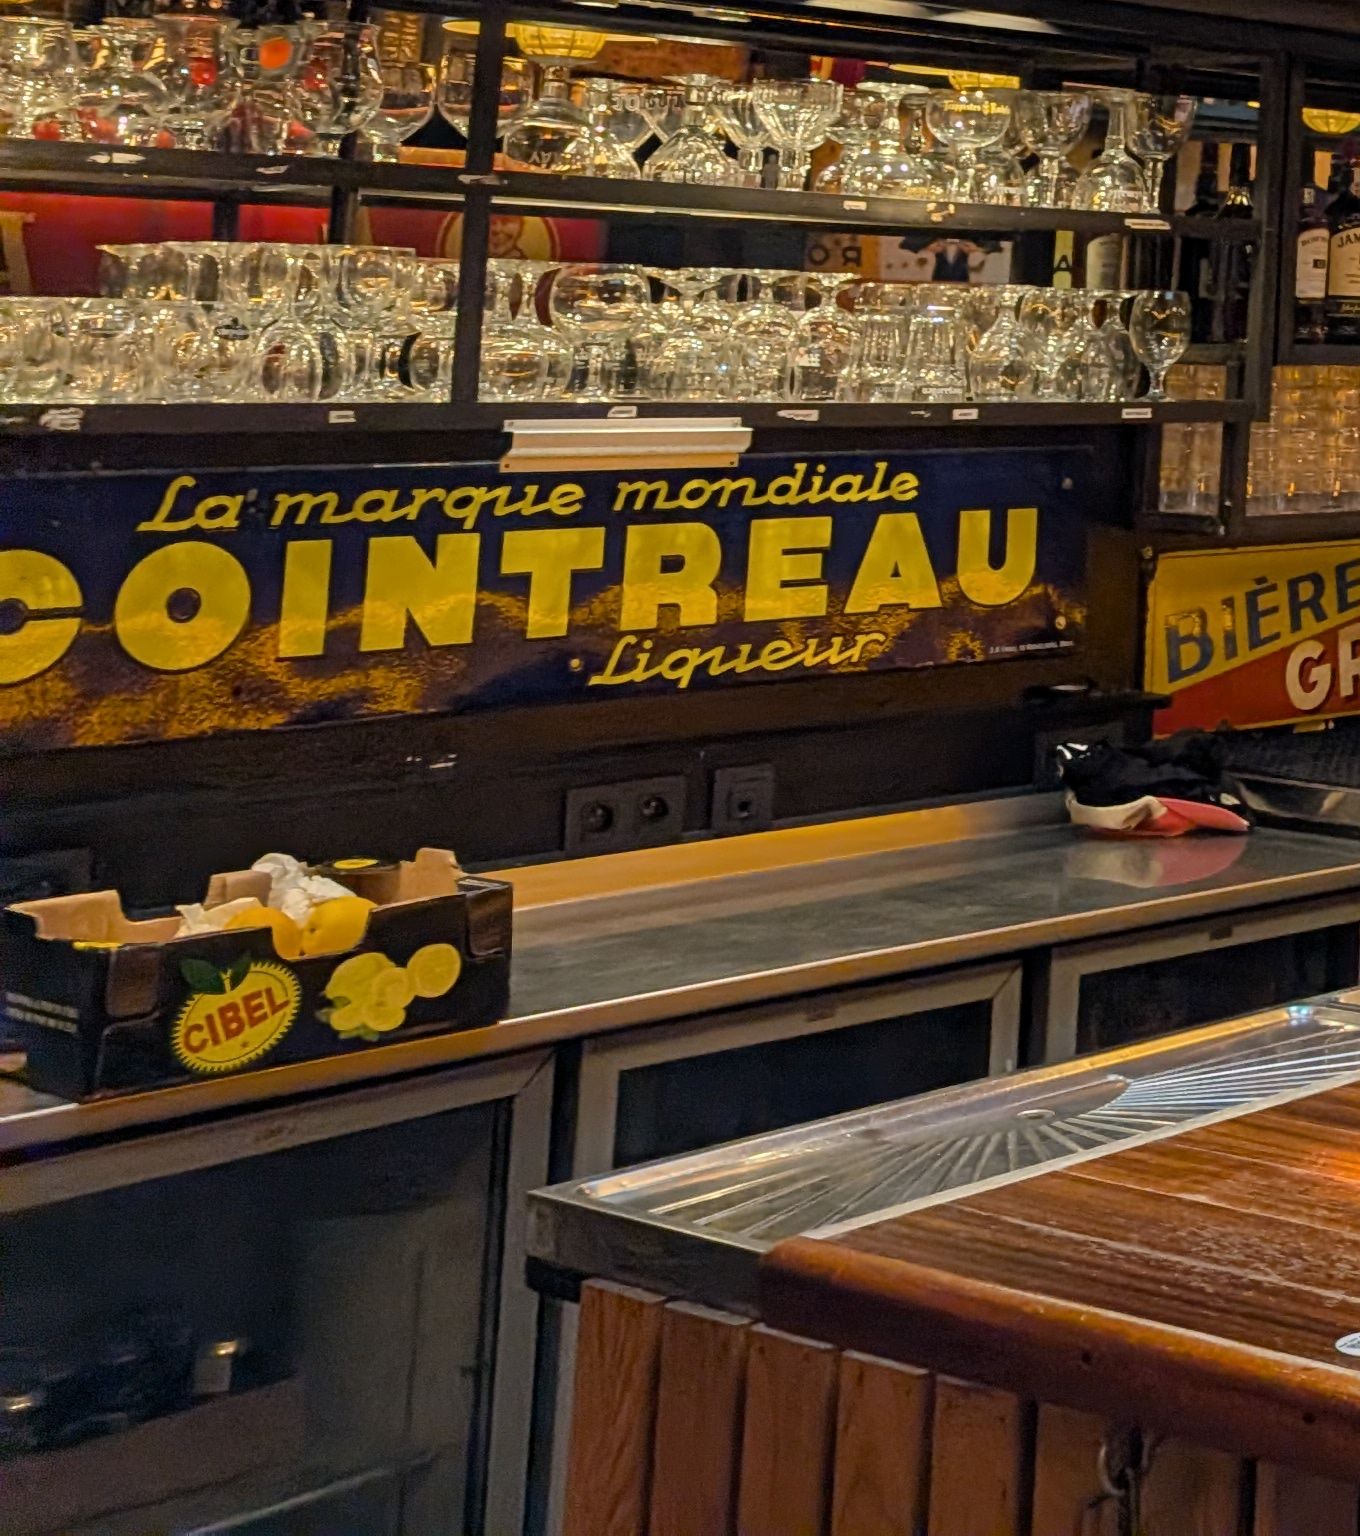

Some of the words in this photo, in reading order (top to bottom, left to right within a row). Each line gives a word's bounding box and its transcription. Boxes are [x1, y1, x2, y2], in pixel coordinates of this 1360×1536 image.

[136, 474, 243, 533] La
[268, 480, 585, 531] marque
[613, 462, 919, 513] mondiale
[0, 507, 1039, 686] COINTREAU
[588, 632, 889, 689] Liqueur
[182, 985, 292, 1056] CIBEL
